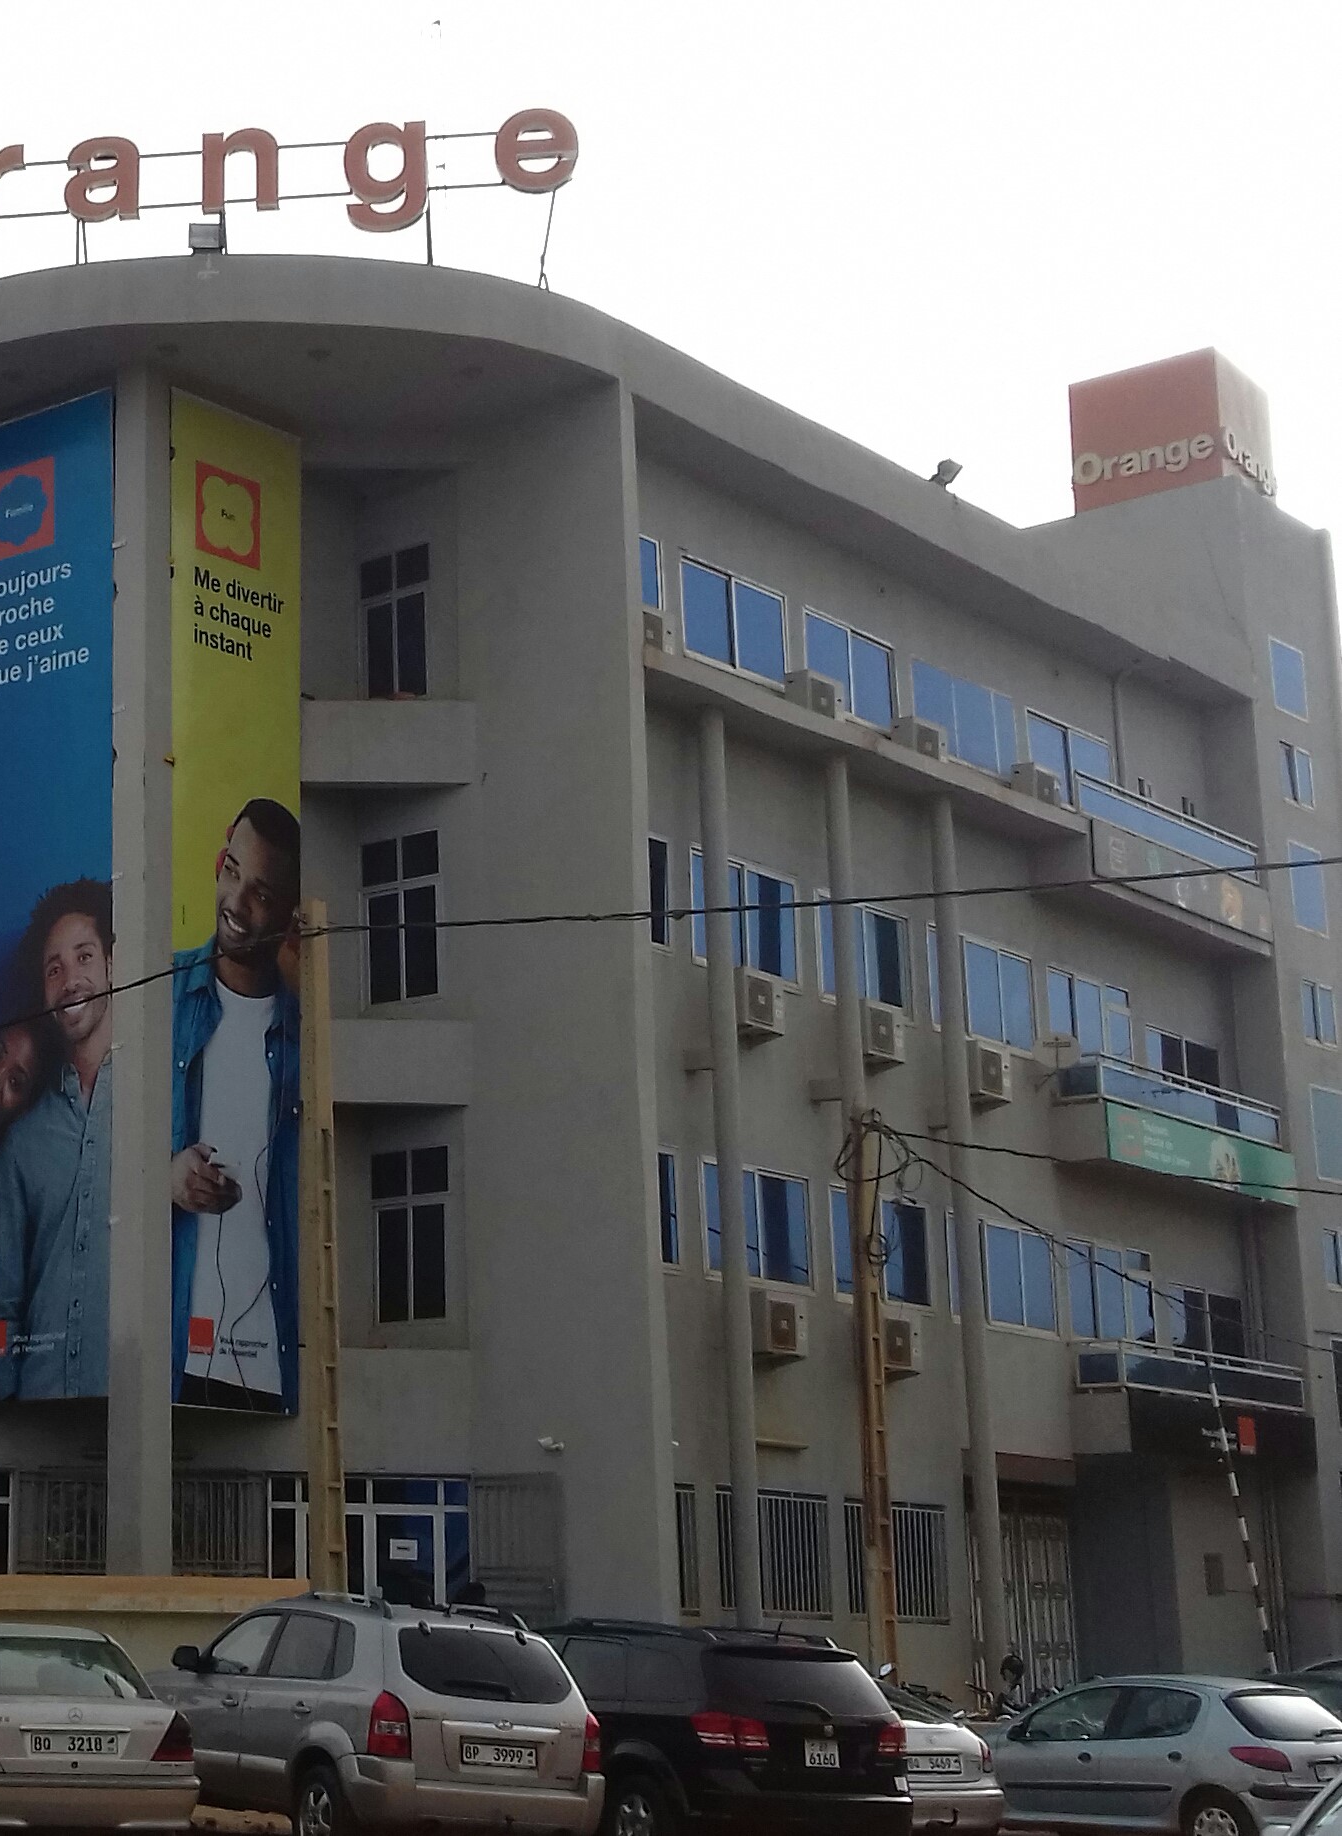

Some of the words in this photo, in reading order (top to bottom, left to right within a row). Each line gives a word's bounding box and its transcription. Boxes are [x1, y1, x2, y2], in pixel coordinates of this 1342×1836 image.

[1073, 432, 1215, 486] Orange
[1224, 429, 1277, 496] Orang
[194, 566, 221, 594] Me
[225, 578, 285, 614] divertir
[15, 622, 64, 652] ceux
[194, 598, 205, 617] à
[209, 603, 272, 639] chaque
[194, 624, 253, 661] instant
[26, 645, 90, 682] j'aime
[68, 1736, 103, 1752] 3218
[493, 1747, 523, 1764] 3999
[809, 1752, 836, 1766] 6160
